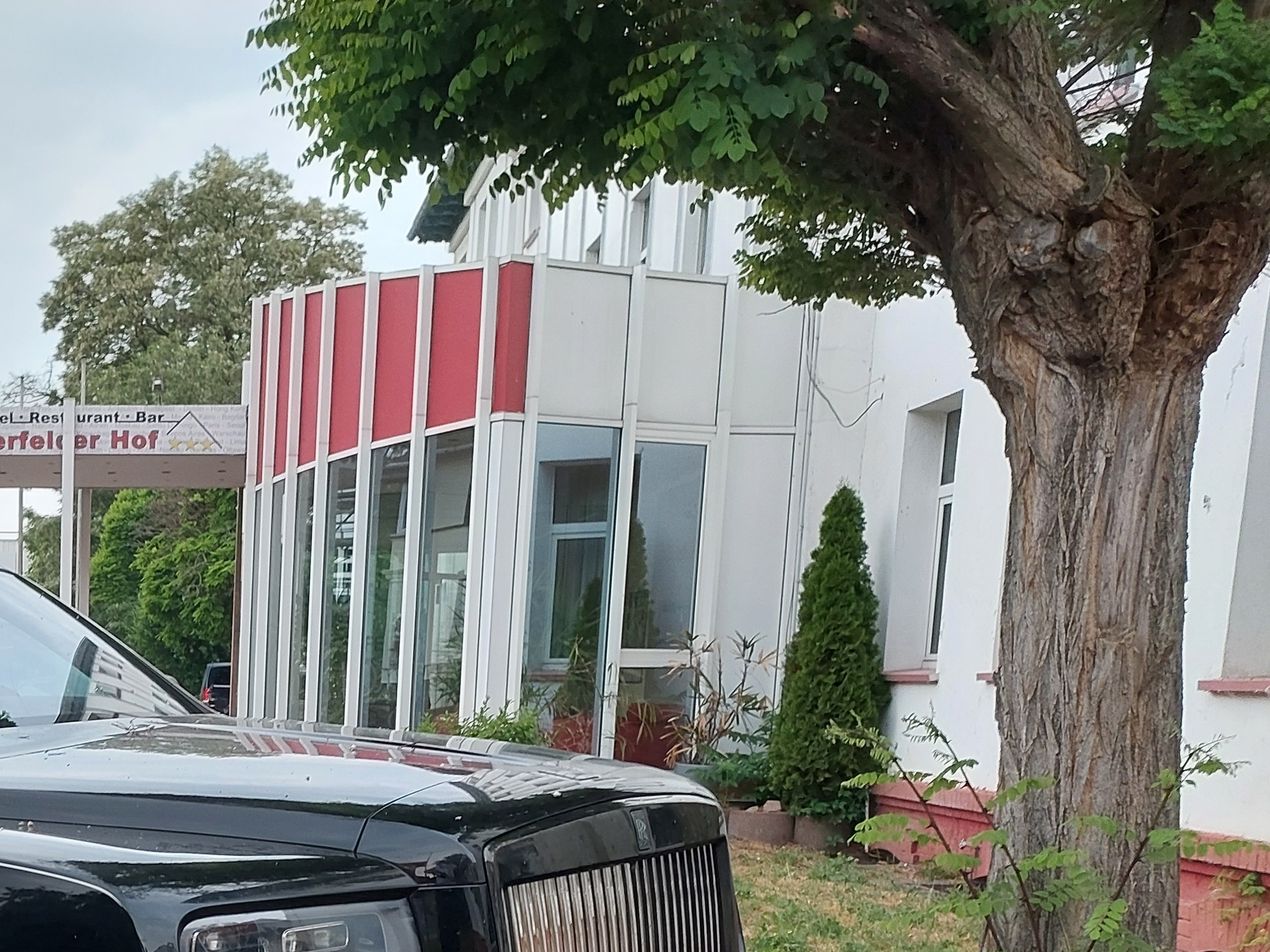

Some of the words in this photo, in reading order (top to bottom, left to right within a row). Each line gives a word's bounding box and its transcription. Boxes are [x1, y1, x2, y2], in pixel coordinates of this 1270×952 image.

[30, 411, 120, 424] Resturant
[136, 411, 164, 423] Bar
[111, 429, 159, 450] Hof
